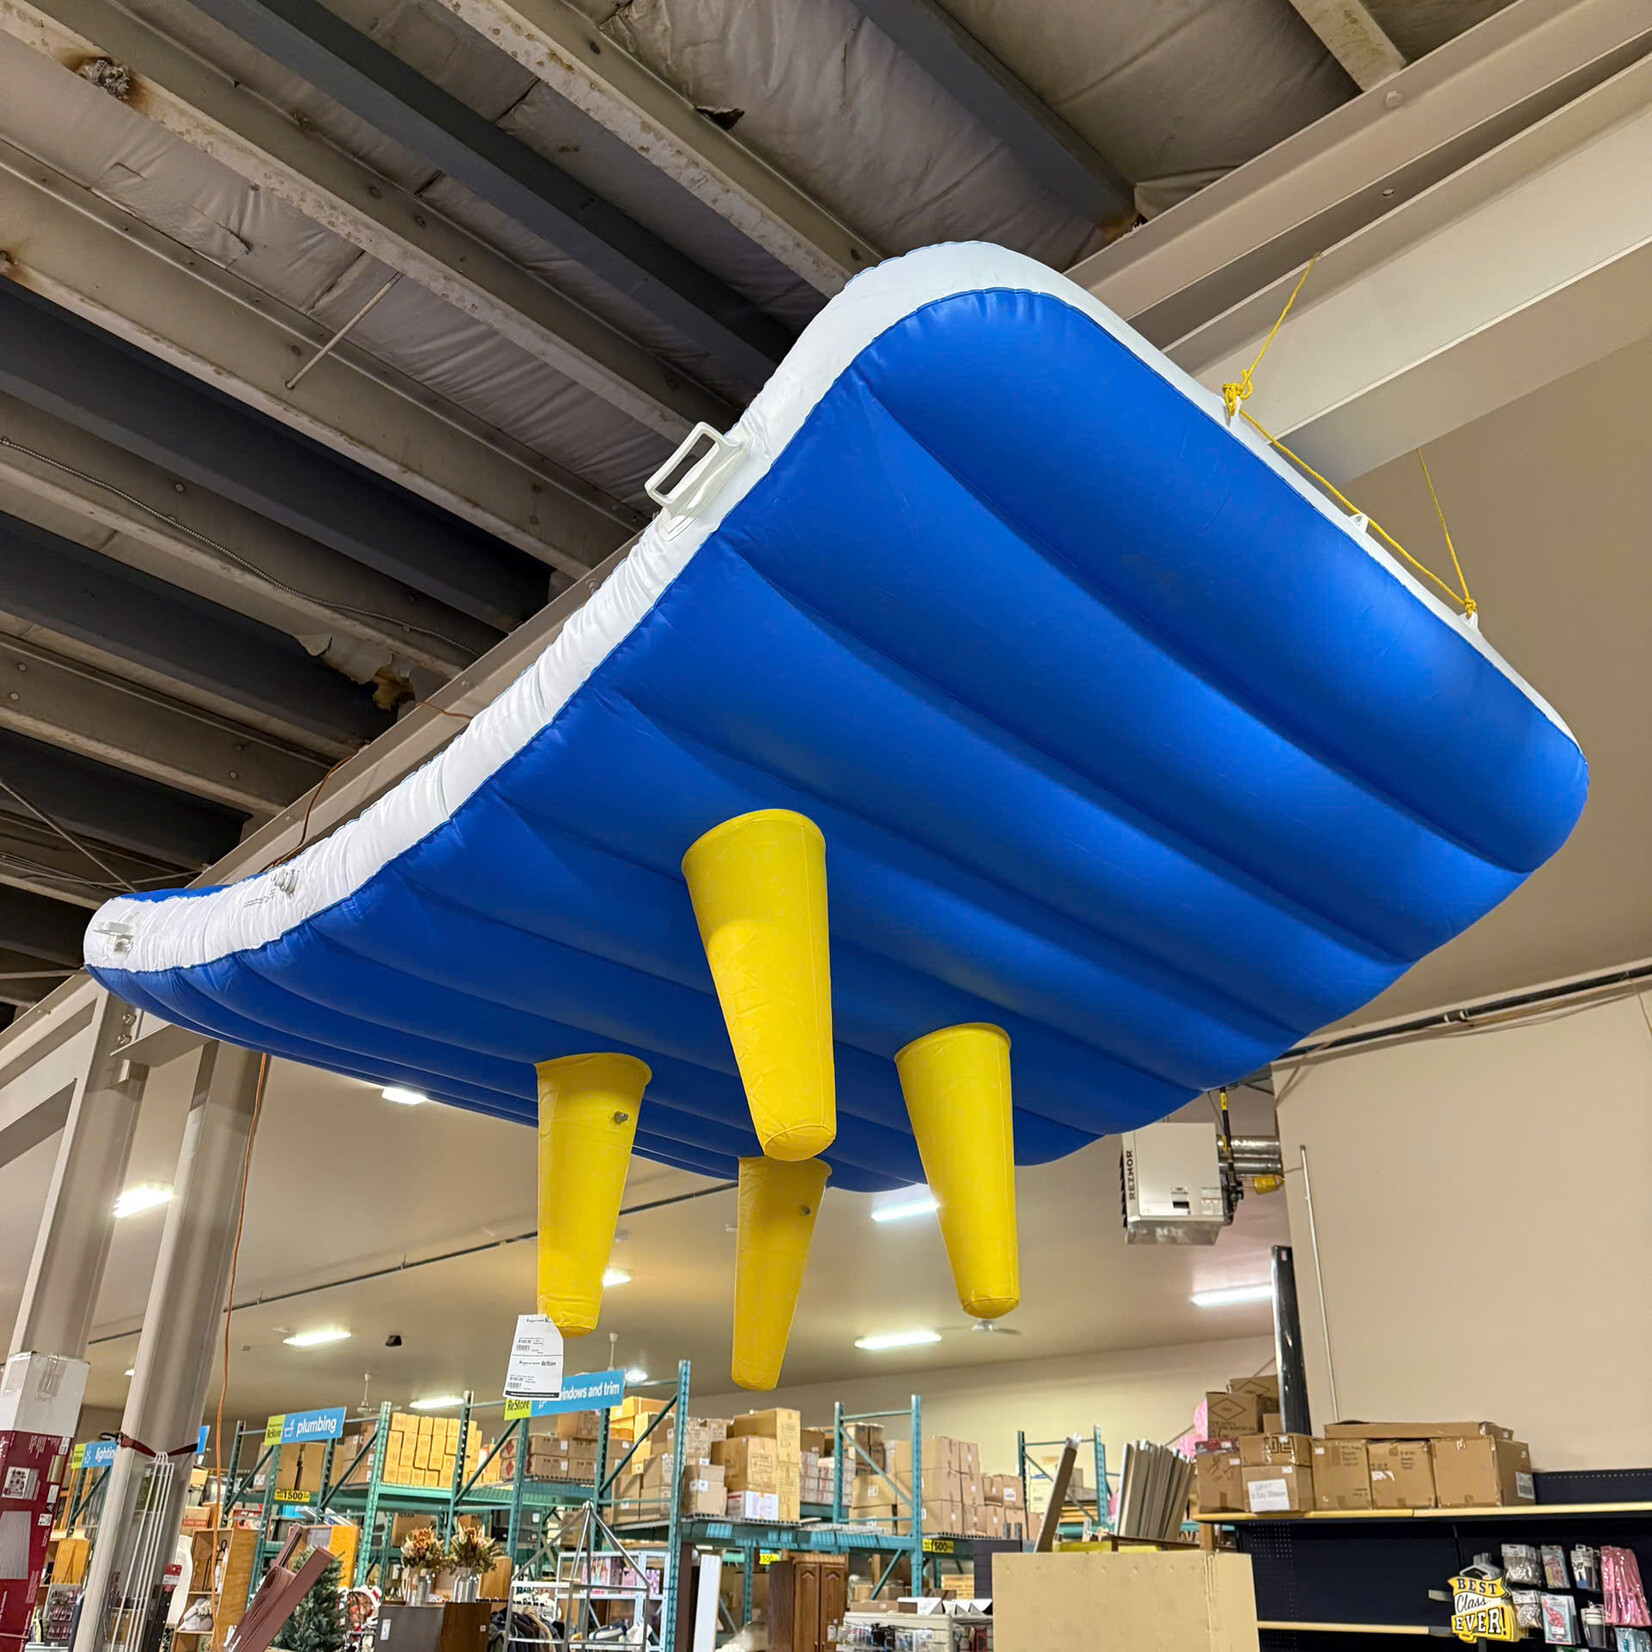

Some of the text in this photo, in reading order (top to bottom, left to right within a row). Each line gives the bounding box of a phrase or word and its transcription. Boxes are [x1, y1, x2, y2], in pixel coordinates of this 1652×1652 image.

[1125, 1149, 1136, 1200] REZNOR
[561, 1380, 620, 1400] indows and trim
[507, 1399, 530, 1411] ReStore
[296, 1415, 337, 1438] plumbing
[283, 1490, 303, 1500] 1500
[1456, 1578, 1496, 1595] BEST
[1456, 1593, 1488, 1613] Class
[1455, 1606, 1506, 1636] EVER!
